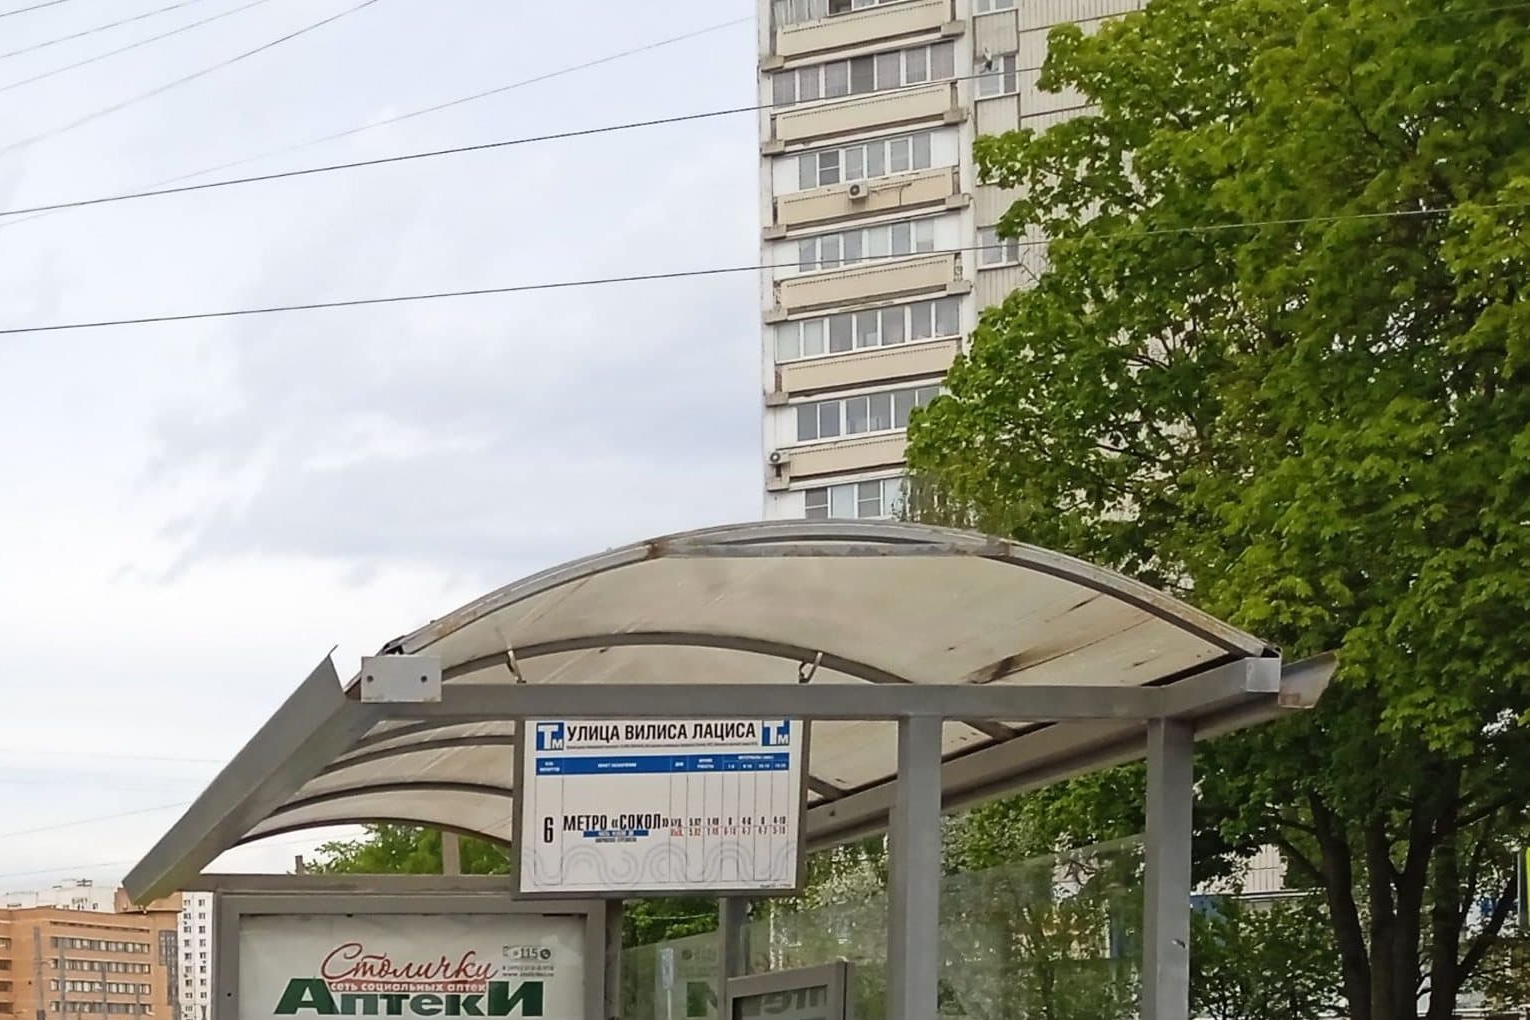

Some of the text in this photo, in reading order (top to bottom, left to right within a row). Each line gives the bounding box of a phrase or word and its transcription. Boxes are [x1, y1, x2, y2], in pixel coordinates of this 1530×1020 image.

[567, 722, 756, 743] УЛИЦА ВИЛИСА ЛАЦИСА
[543, 816, 554, 843] 6
[563, 814, 607, 831] МЕТРО
[611, 813, 669, 830] «СОКОЛ»
[321, 942, 499, 980] Столички
[330, 982, 486, 993] сеть социальных аптек
